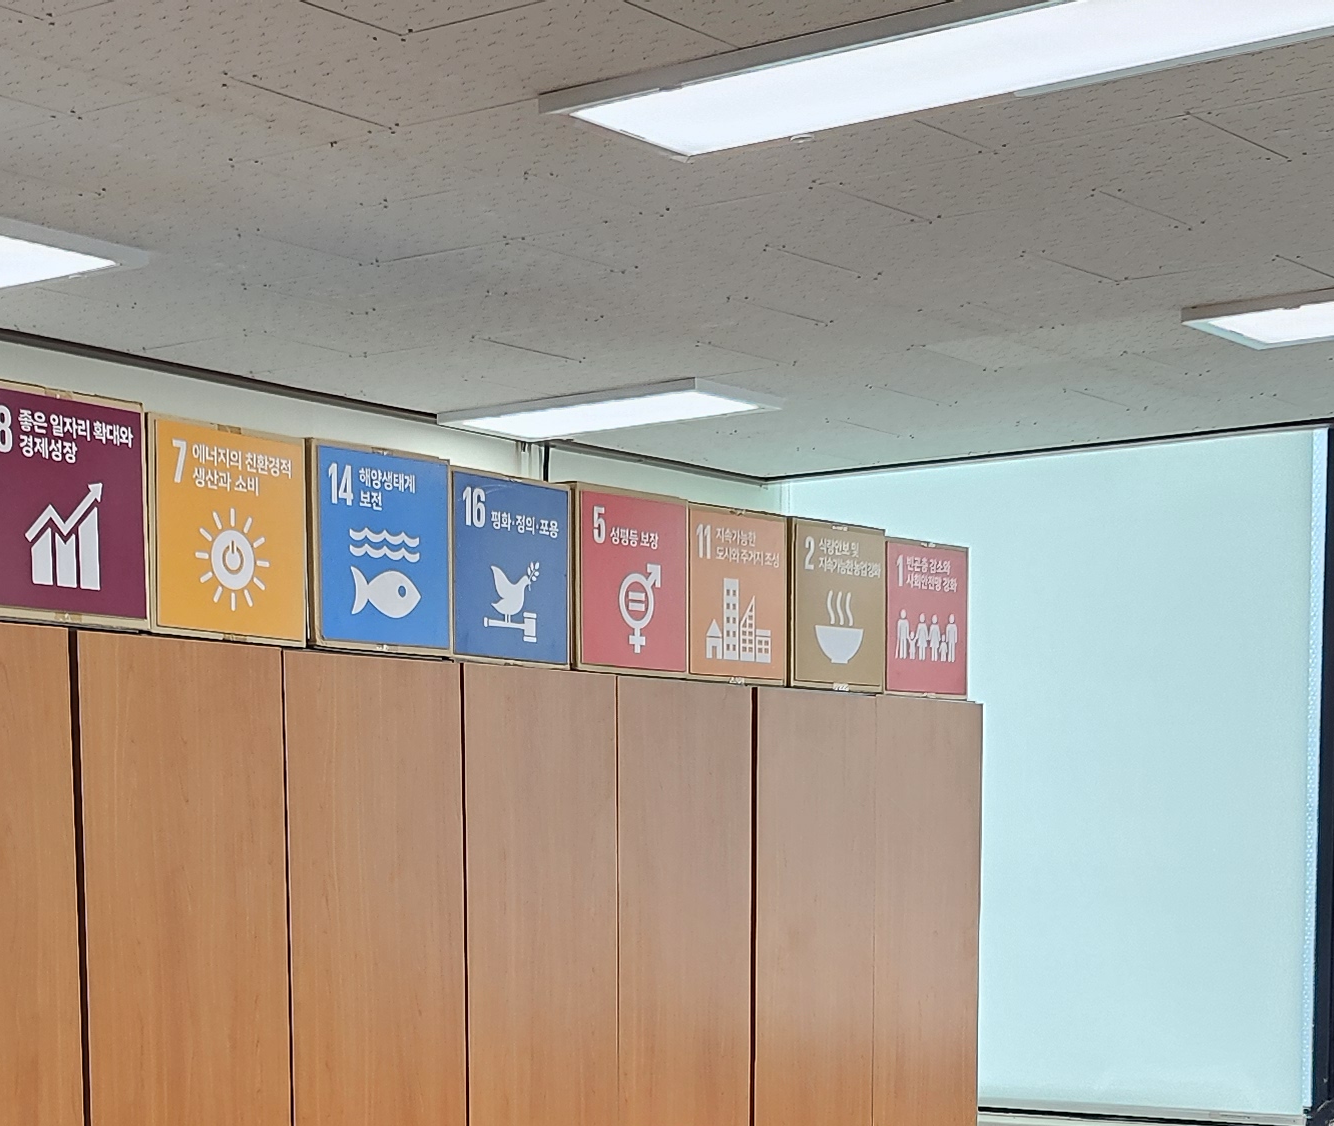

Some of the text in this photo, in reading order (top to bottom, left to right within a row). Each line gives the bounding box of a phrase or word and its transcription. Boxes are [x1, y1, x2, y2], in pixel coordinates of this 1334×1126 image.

[18, 410, 134, 449] 좋은 일자리 확대와
[19, 435, 77, 464] 경제성장
[172, 439, 187, 483] 7
[192, 443, 293, 479] 에너지의 친환경적
[192, 471, 259, 496] 생산과 소비
[328, 462, 354, 506] 14
[359, 467, 415, 494] 해양생태계
[359, 491, 383, 511] 보전
[462, 486, 486, 528] 16
[592, 506, 606, 543] 5
[610, 525, 659, 550] 성평등 보장
[696, 523, 711, 559] 11
[715, 527, 756, 547] 지속가능한
[715, 547, 779, 568] 도시와 주거지 조성
[805, 536, 815, 570] 2
[896, 555, 904, 587] 1
